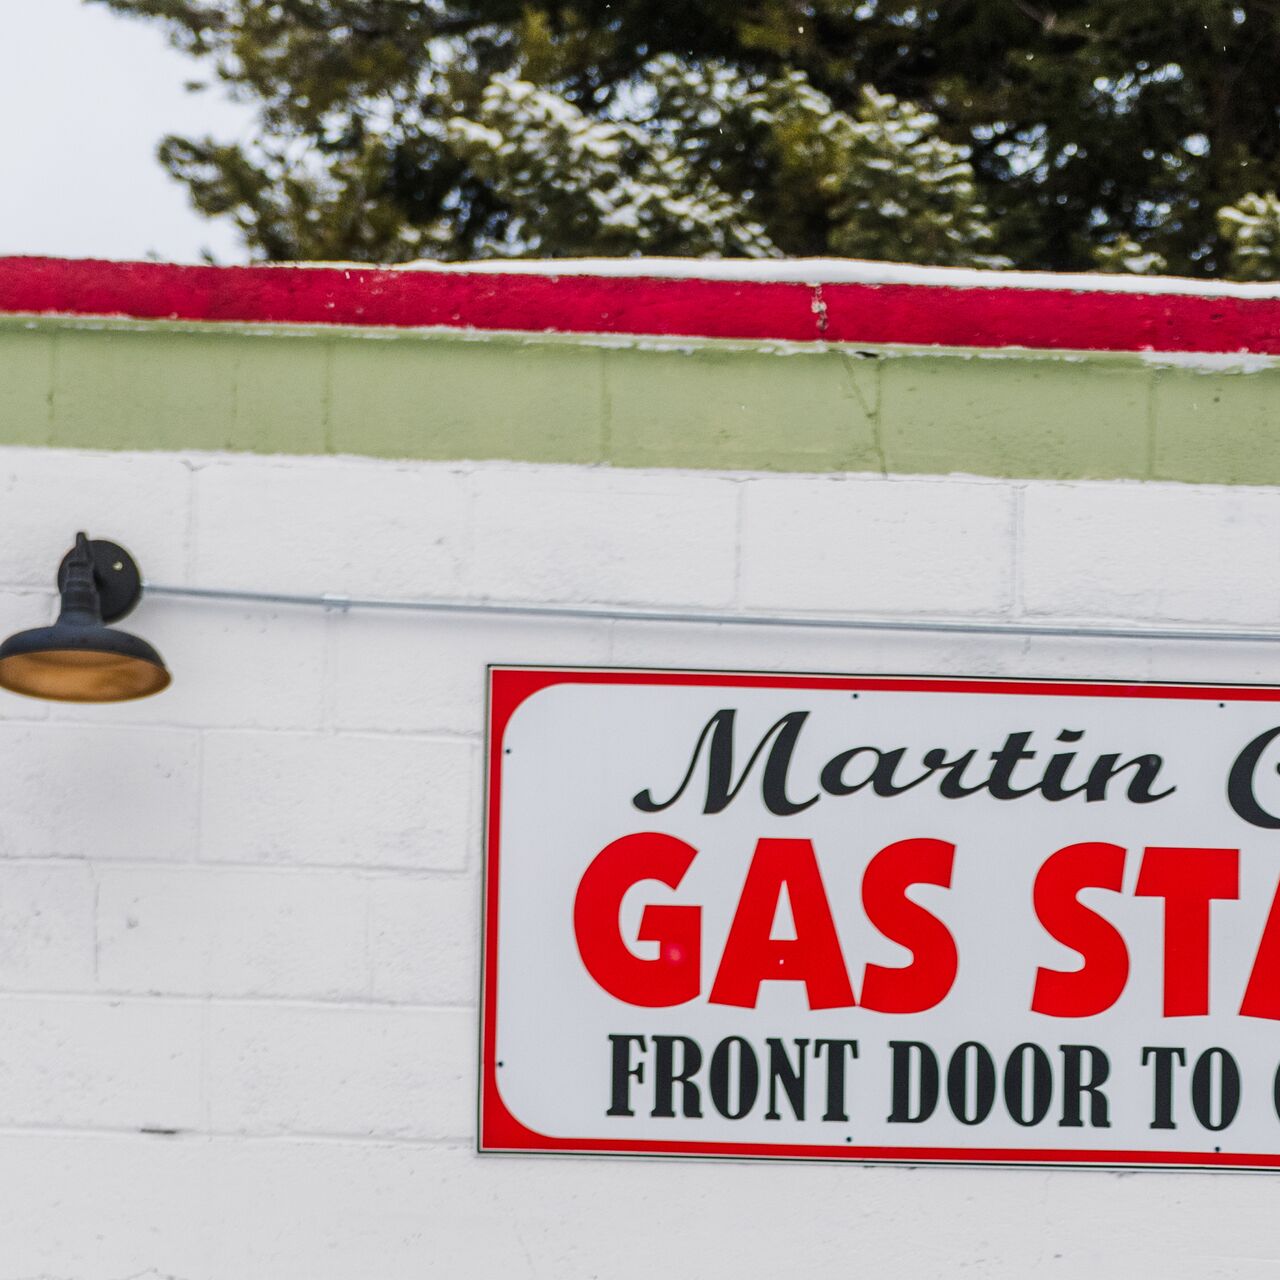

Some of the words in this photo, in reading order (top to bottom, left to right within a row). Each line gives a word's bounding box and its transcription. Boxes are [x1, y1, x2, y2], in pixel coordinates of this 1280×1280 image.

[633, 708, 1176, 817] Martin
[573, 831, 959, 1016] GAS
[605, 1033, 859, 1122] FRONT
[886, 1038, 1112, 1130] DOOR
[1141, 1045, 1242, 1132] TO
